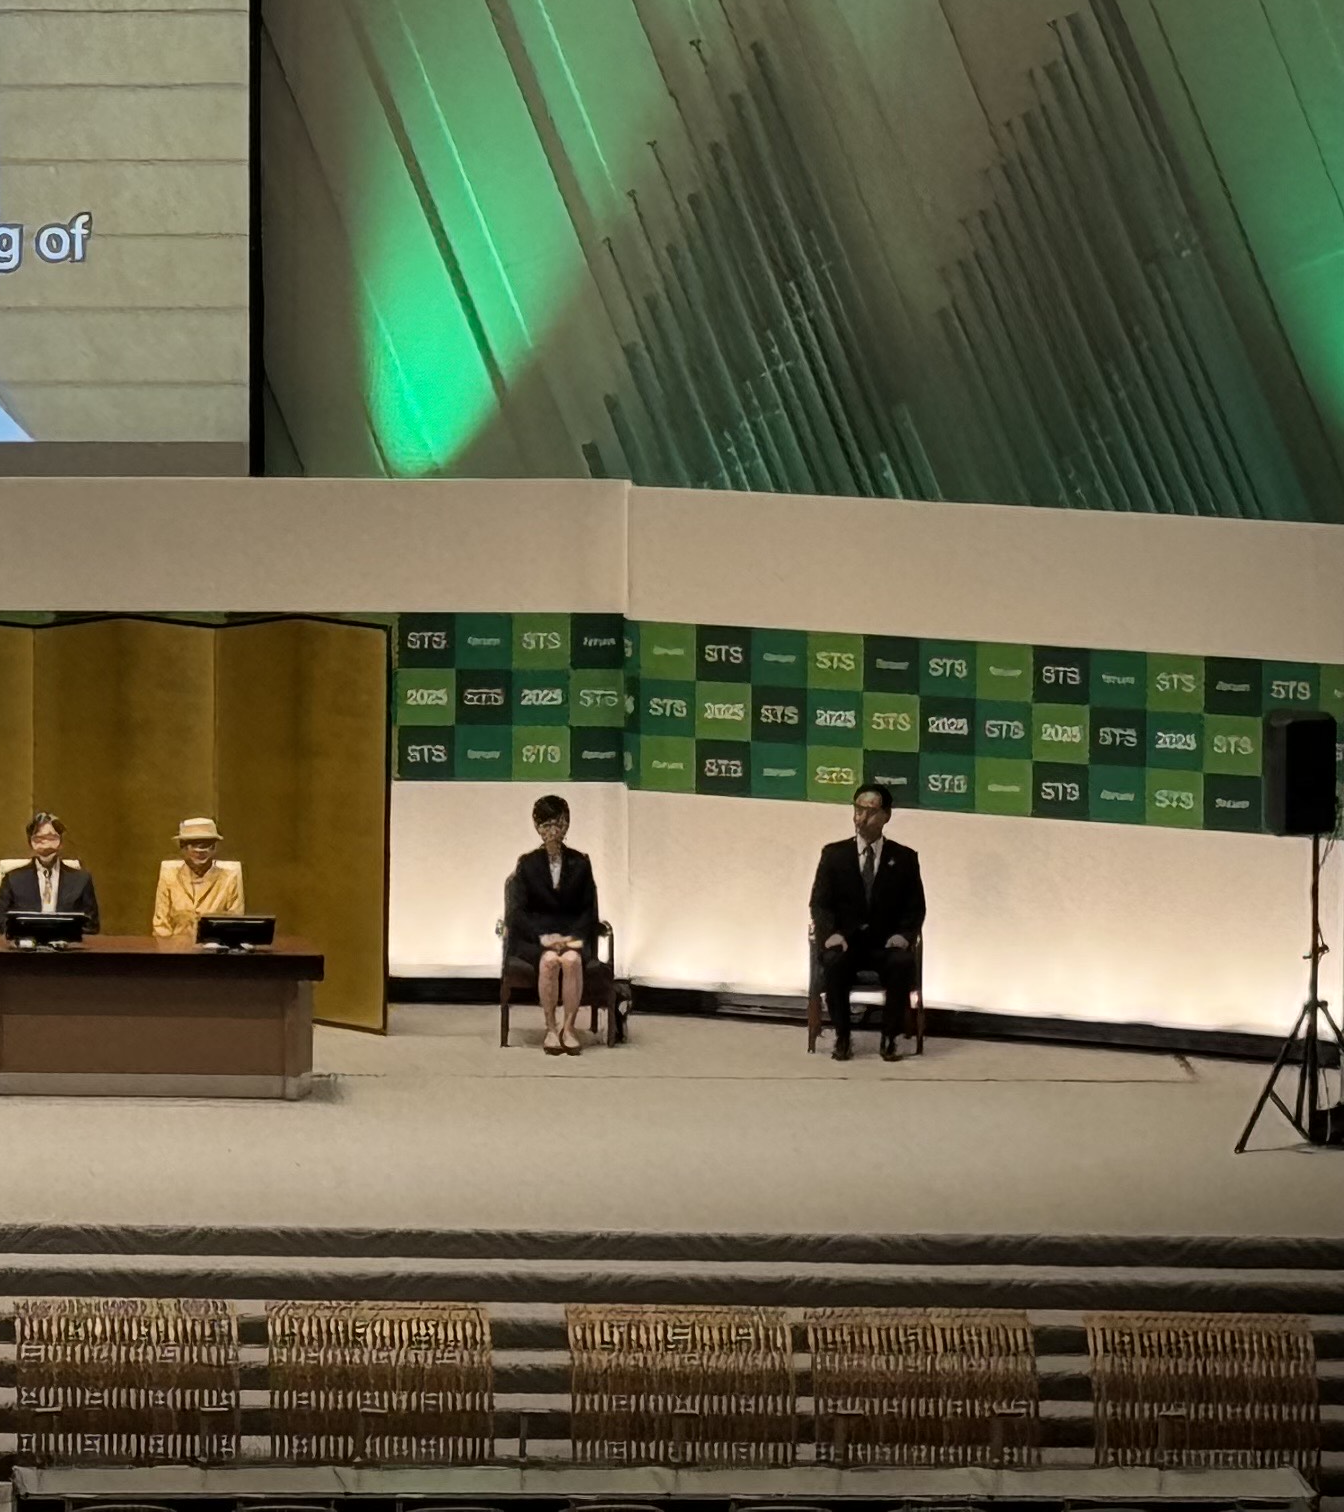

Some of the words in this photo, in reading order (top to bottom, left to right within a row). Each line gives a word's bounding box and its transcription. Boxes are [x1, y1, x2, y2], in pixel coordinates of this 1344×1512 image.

[36, 213, 91, 259] of
[407, 631, 447, 650] STS
[522, 631, 562, 650] STS
[704, 644, 744, 664] STS
[815, 651, 856, 672] STS
[1155, 672, 1197, 693] STS
[1270, 680, 1311, 701] STS
[578, 689, 619, 708] STS
[871, 712, 912, 732] STS
[407, 744, 448, 764] STS
[1213, 734, 1254, 755] STS
